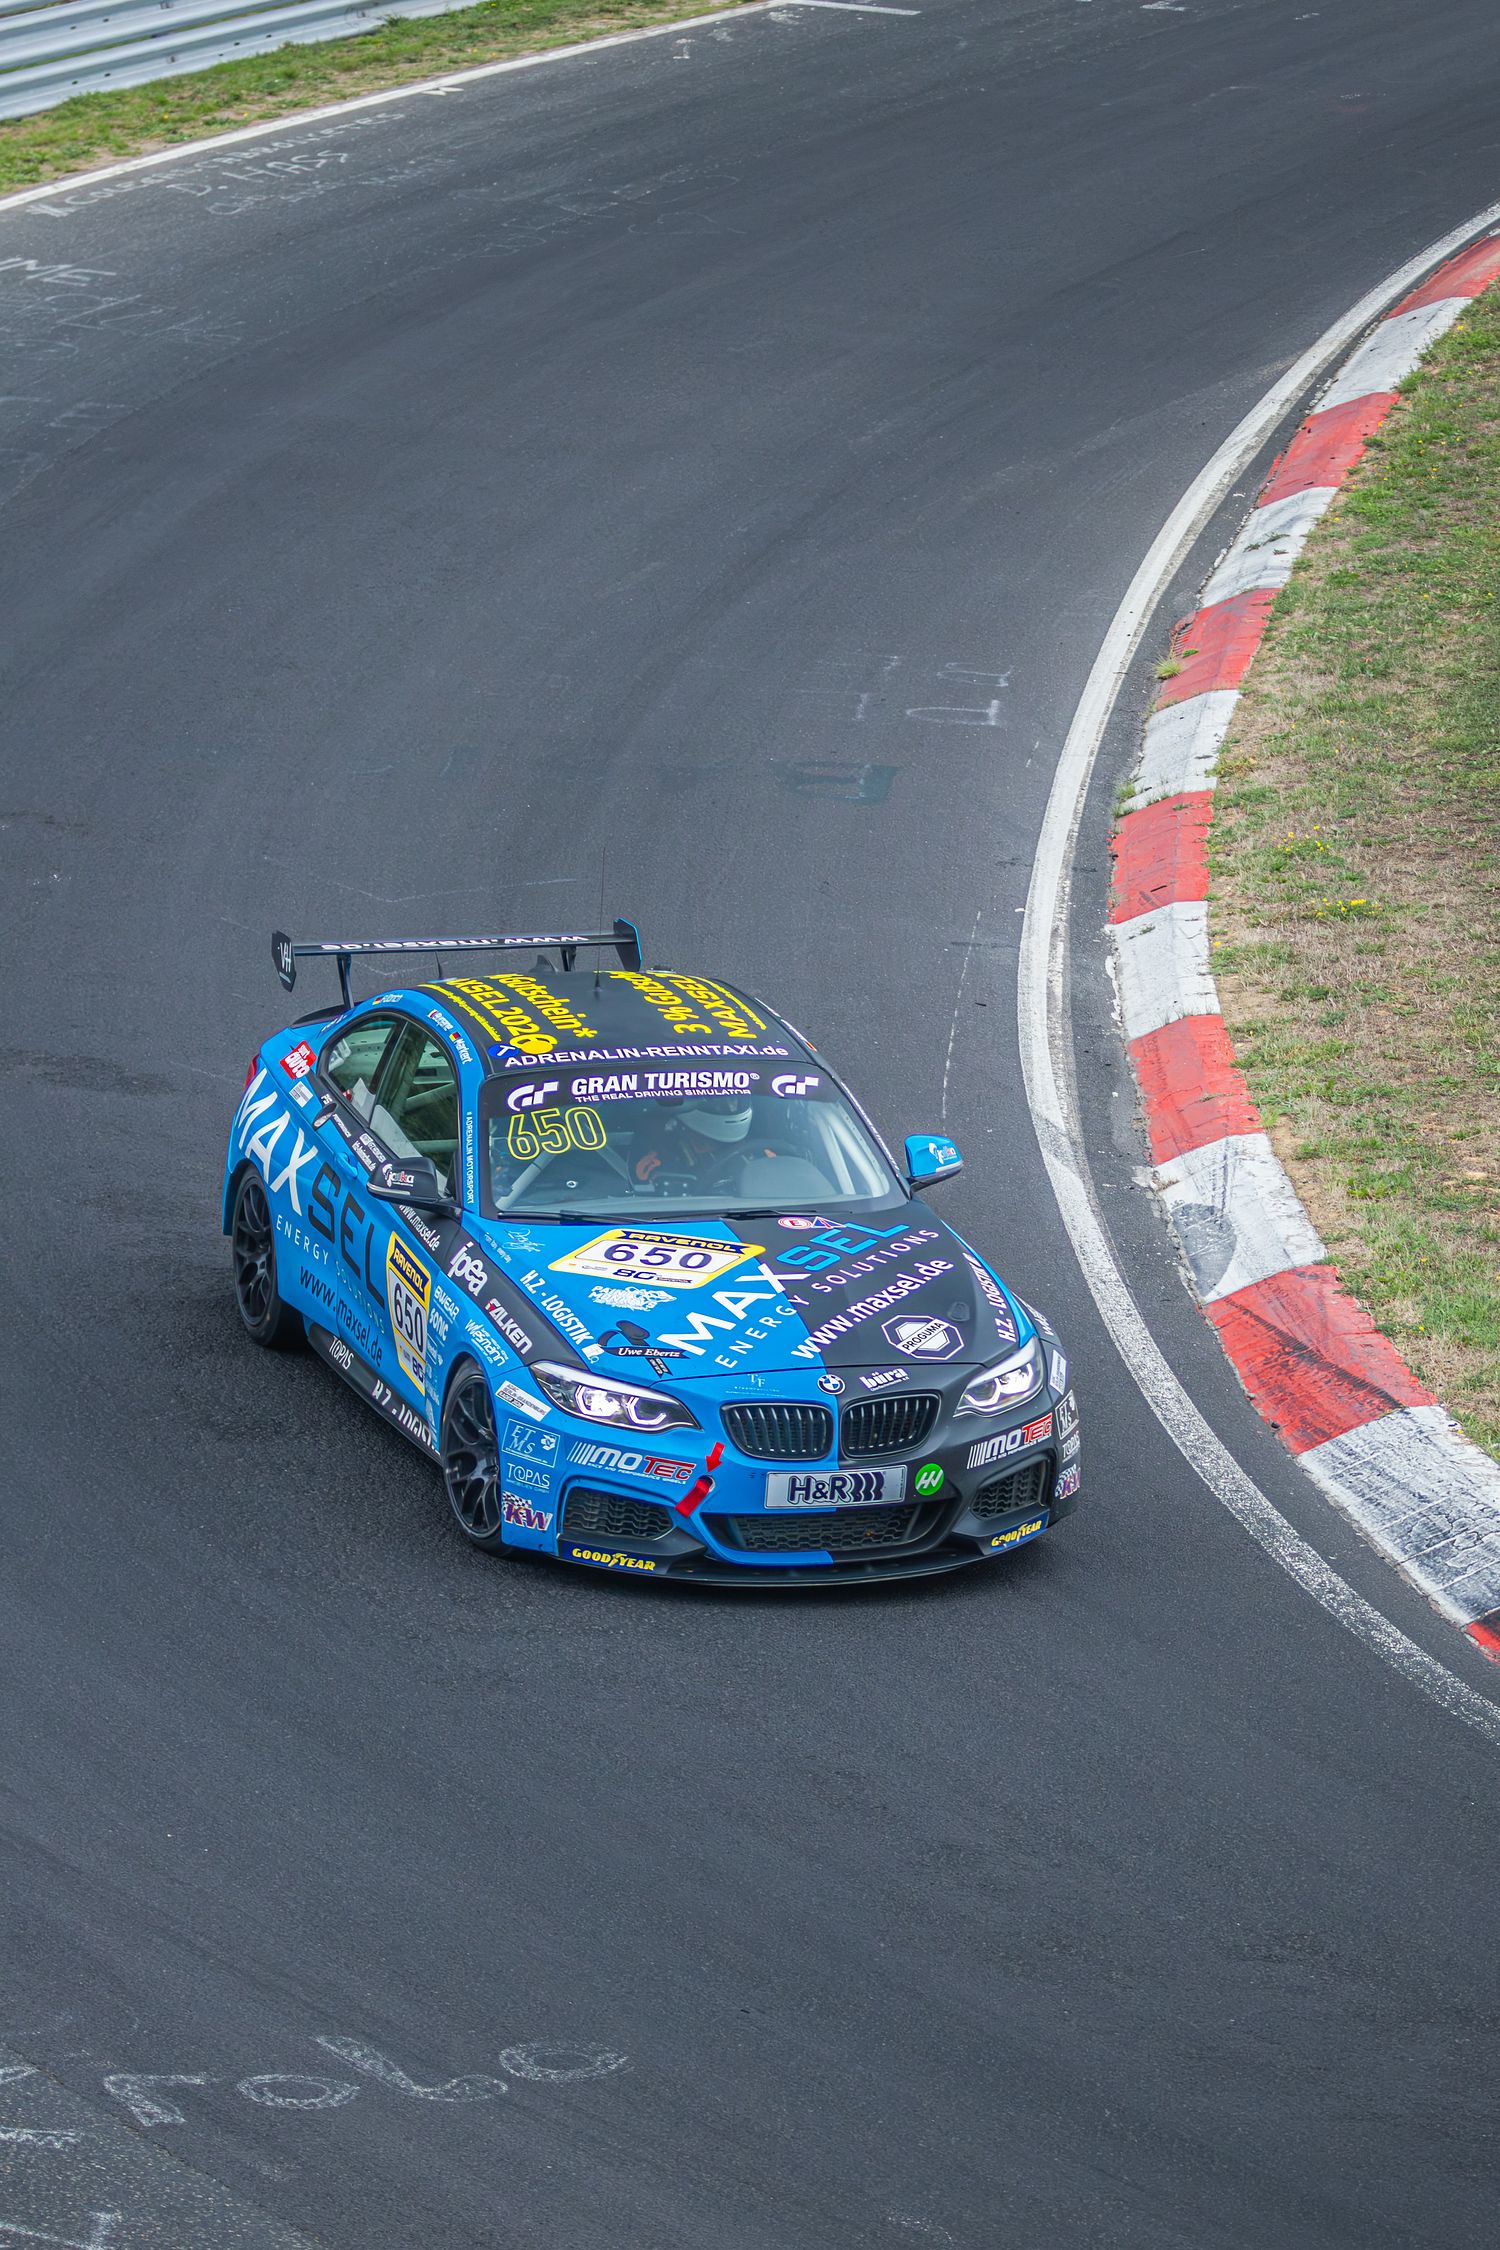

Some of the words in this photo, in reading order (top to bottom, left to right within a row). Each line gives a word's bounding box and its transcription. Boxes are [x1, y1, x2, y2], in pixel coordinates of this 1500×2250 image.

[222, 150, 349, 184] HASS
[505, 1044, 788, 1067] ADRENALIN-RENNTAXI.de
[571, 1075, 638, 1096] GRAN
[575, 1095, 599, 1103] THE
[601, 1092, 634, 1101] REAL
[635, 1090, 684, 1099] DRIVING
[507, 1106, 607, 1161] 650
[234, 1067, 386, 1310] MAXSEL
[276, 1215, 329, 1265] ENERGY
[604, 1243, 712, 1269] 650
[628, 1231, 736, 1252] RAVENOL
[393, 1241, 424, 1293] RAVENOL
[657, 1223, 910, 1356] MAXSEL
[715, 1295, 810, 1368] ENERGY
[812, 1229, 939, 1293] SOLUTIONS
[300, 1266, 382, 1367] www.maxsel.de
[394, 1283, 424, 1353] 650
[541, 1294, 594, 1345] LOGISTIK
[791, 1258, 954, 1360] www.maxsel.de
[485, 1298, 533, 1355] FALKEN
[902, 1321, 944, 1351] PROGUMA
[329, 1335, 355, 1370] TOPAS
[618, 1347, 643, 1356] Uwe
[645, 1348, 681, 1357] Ebertz
[859, 1368, 908, 1389] büra
[985, 1413, 1053, 1459] MOTEC
[507, 1463, 550, 1487] TOPAS
[590, 1447, 697, 1481] MOTEC
[788, 1475, 852, 1504] H&R
[504, 1503, 553, 1531] KW
[572, 1548, 656, 1571] GOODYEAR
